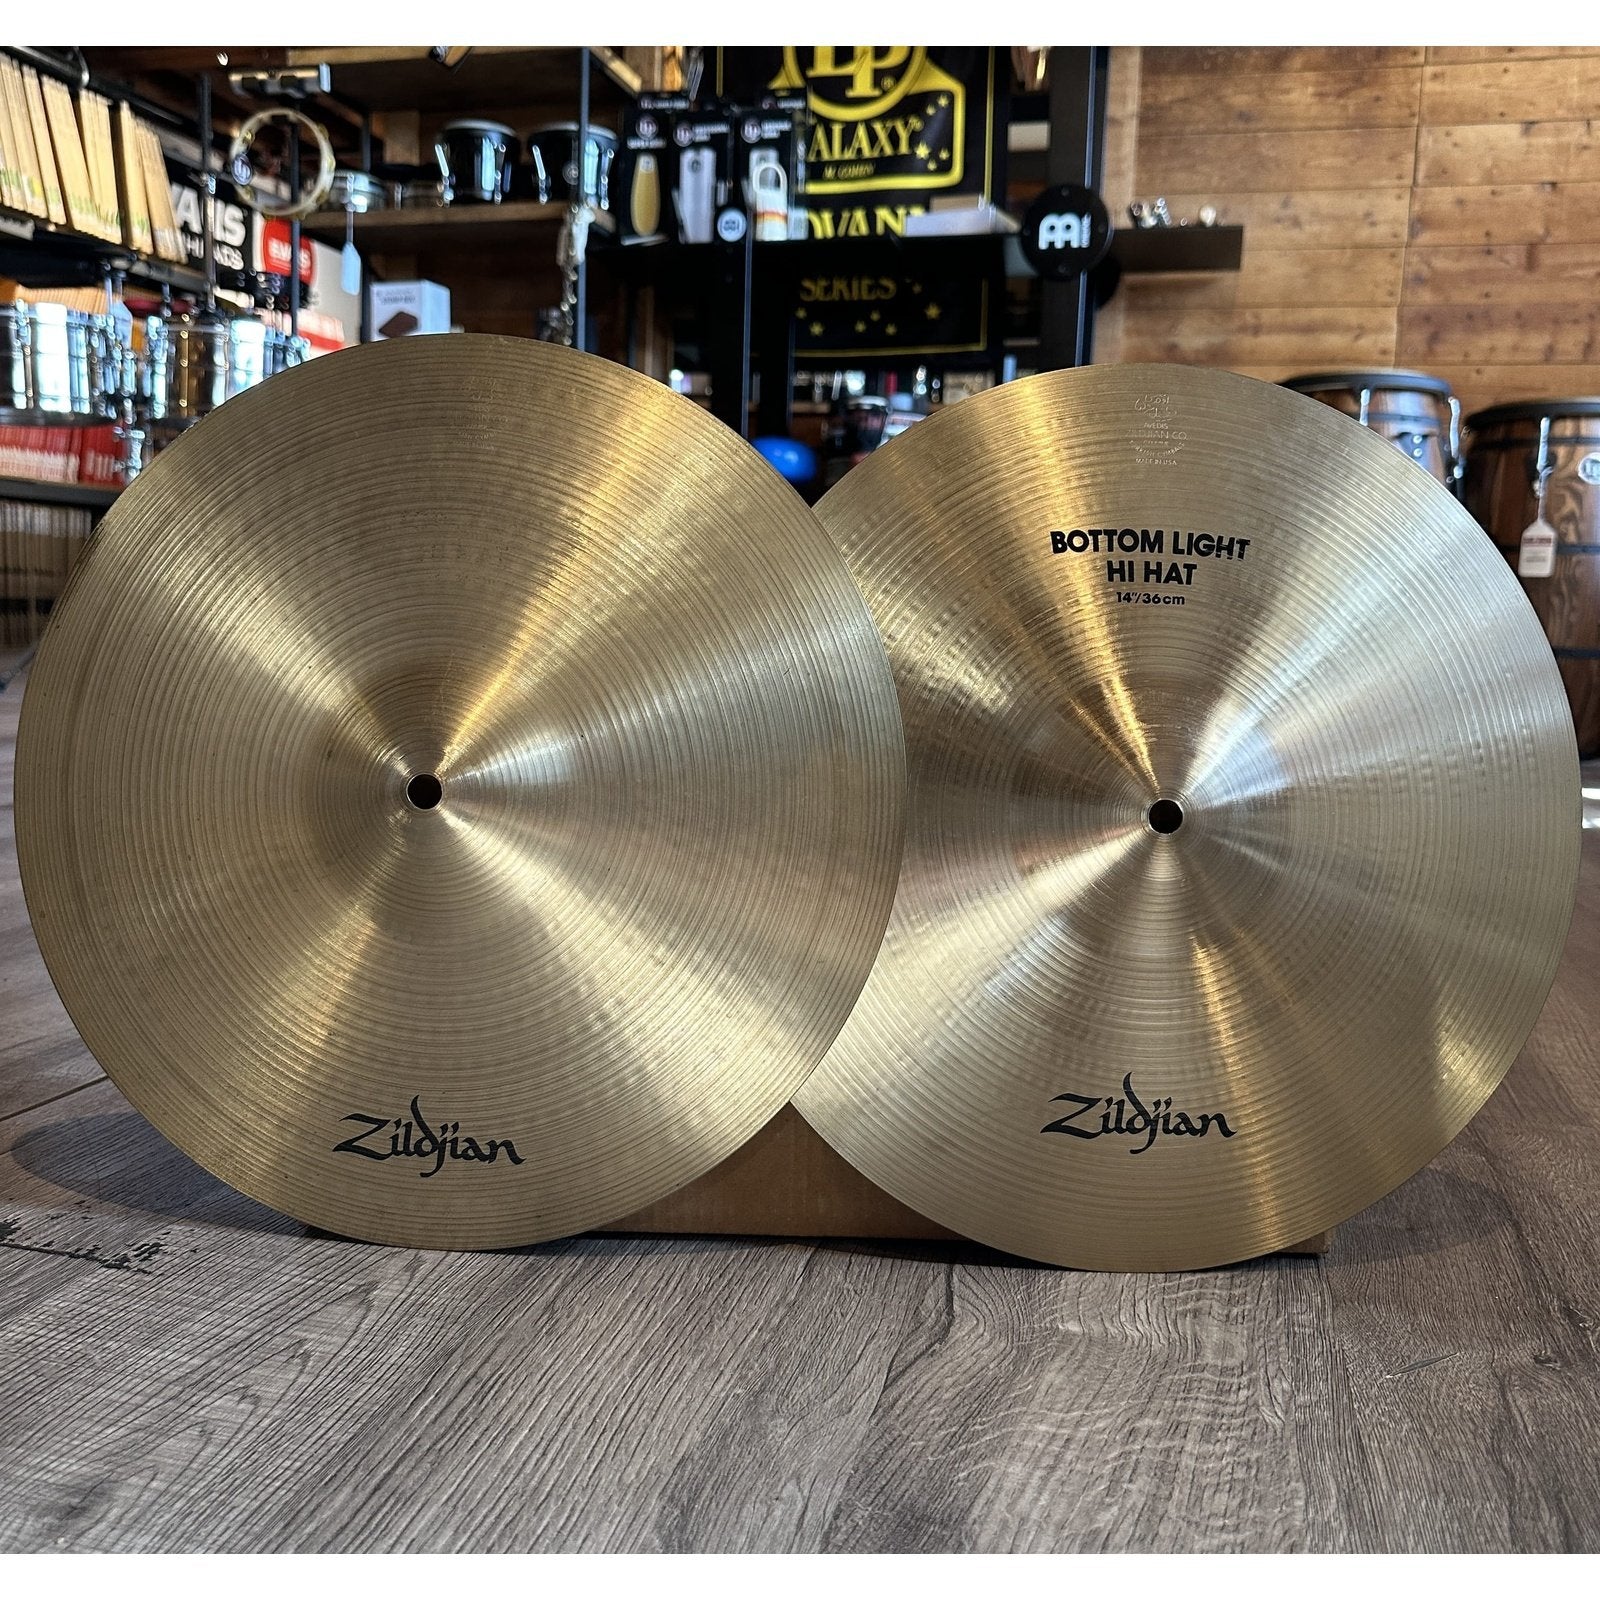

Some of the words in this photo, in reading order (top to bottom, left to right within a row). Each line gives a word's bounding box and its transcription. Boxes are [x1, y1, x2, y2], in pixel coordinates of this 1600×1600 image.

[806, 118, 912, 162] ALAXY
[1050, 528, 1164, 554] BOTTOM
[1172, 531, 1250, 561] LIGHT
[1106, 560, 1135, 582] HI
[1144, 560, 1198, 585] HAT
[1040, 1071, 1238, 1155] Zildjian
[332, 1094, 527, 1178] Zildjian
